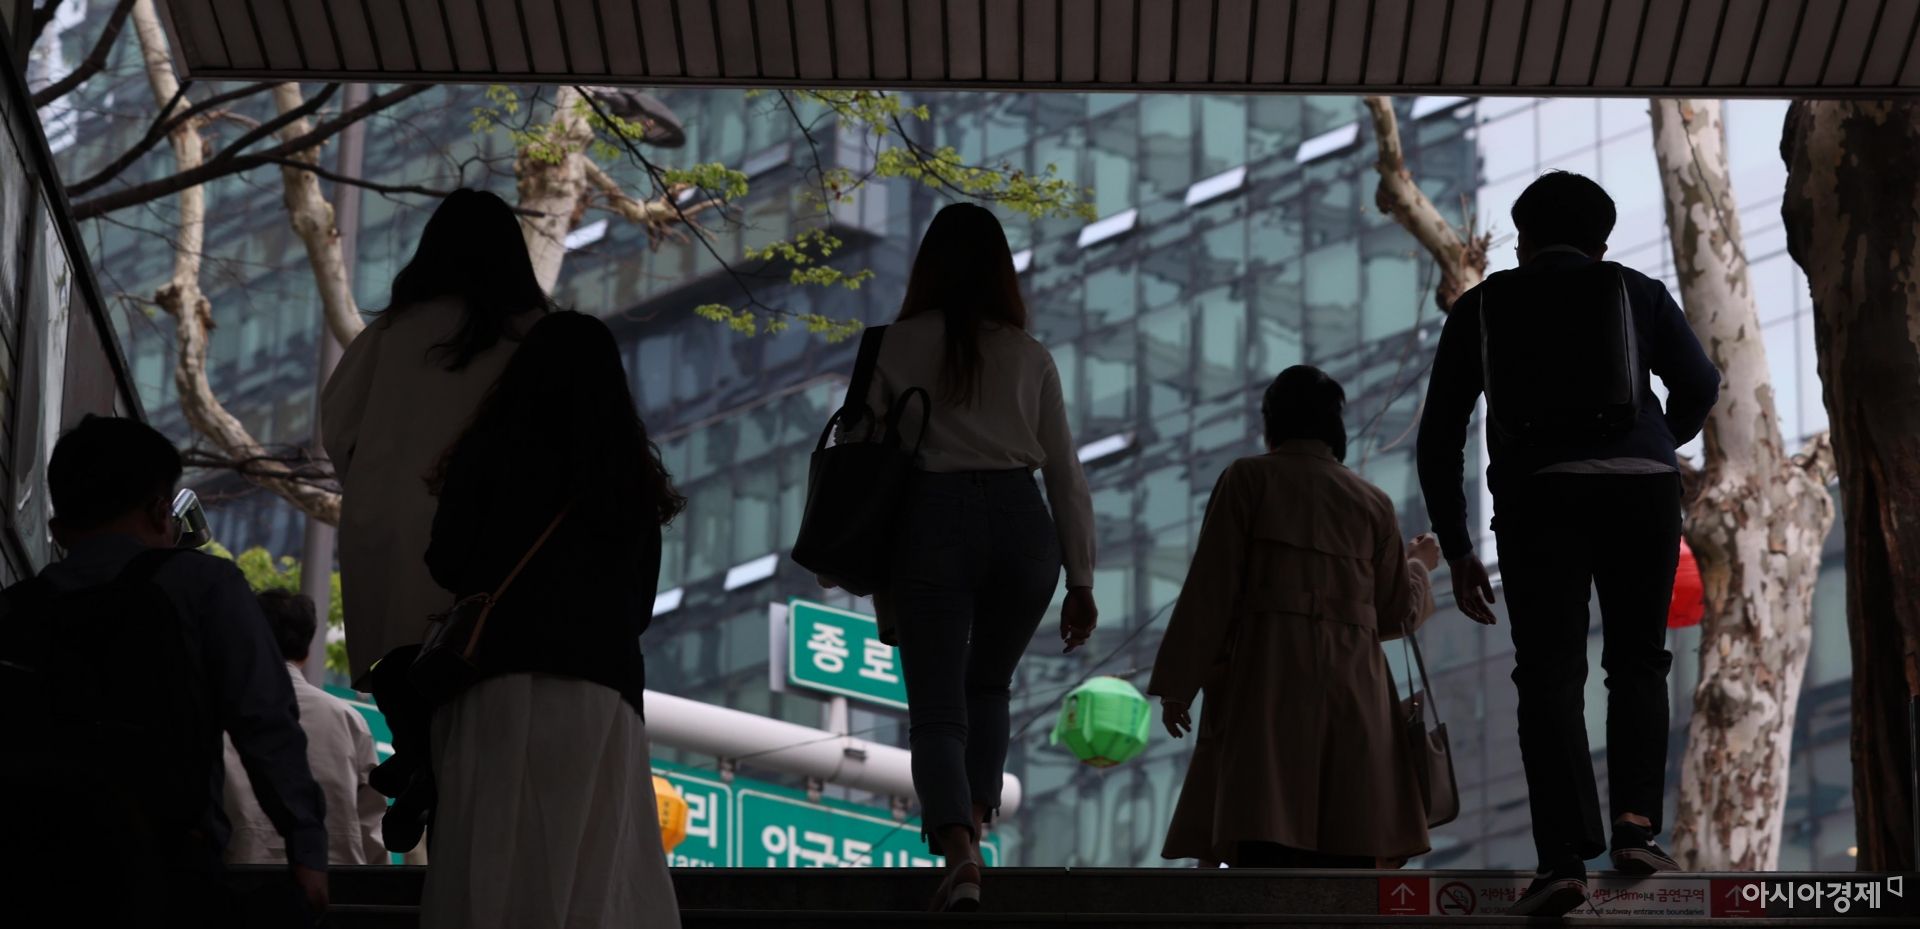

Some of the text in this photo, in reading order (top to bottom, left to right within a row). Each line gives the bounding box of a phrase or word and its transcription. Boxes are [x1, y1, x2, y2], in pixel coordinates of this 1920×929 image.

[807, 622, 900, 684] 종로
[1480, 888, 1516, 902] 지하철
[1656, 888, 1704, 903] 금연구역
[1606, 908, 1632, 916] subway
